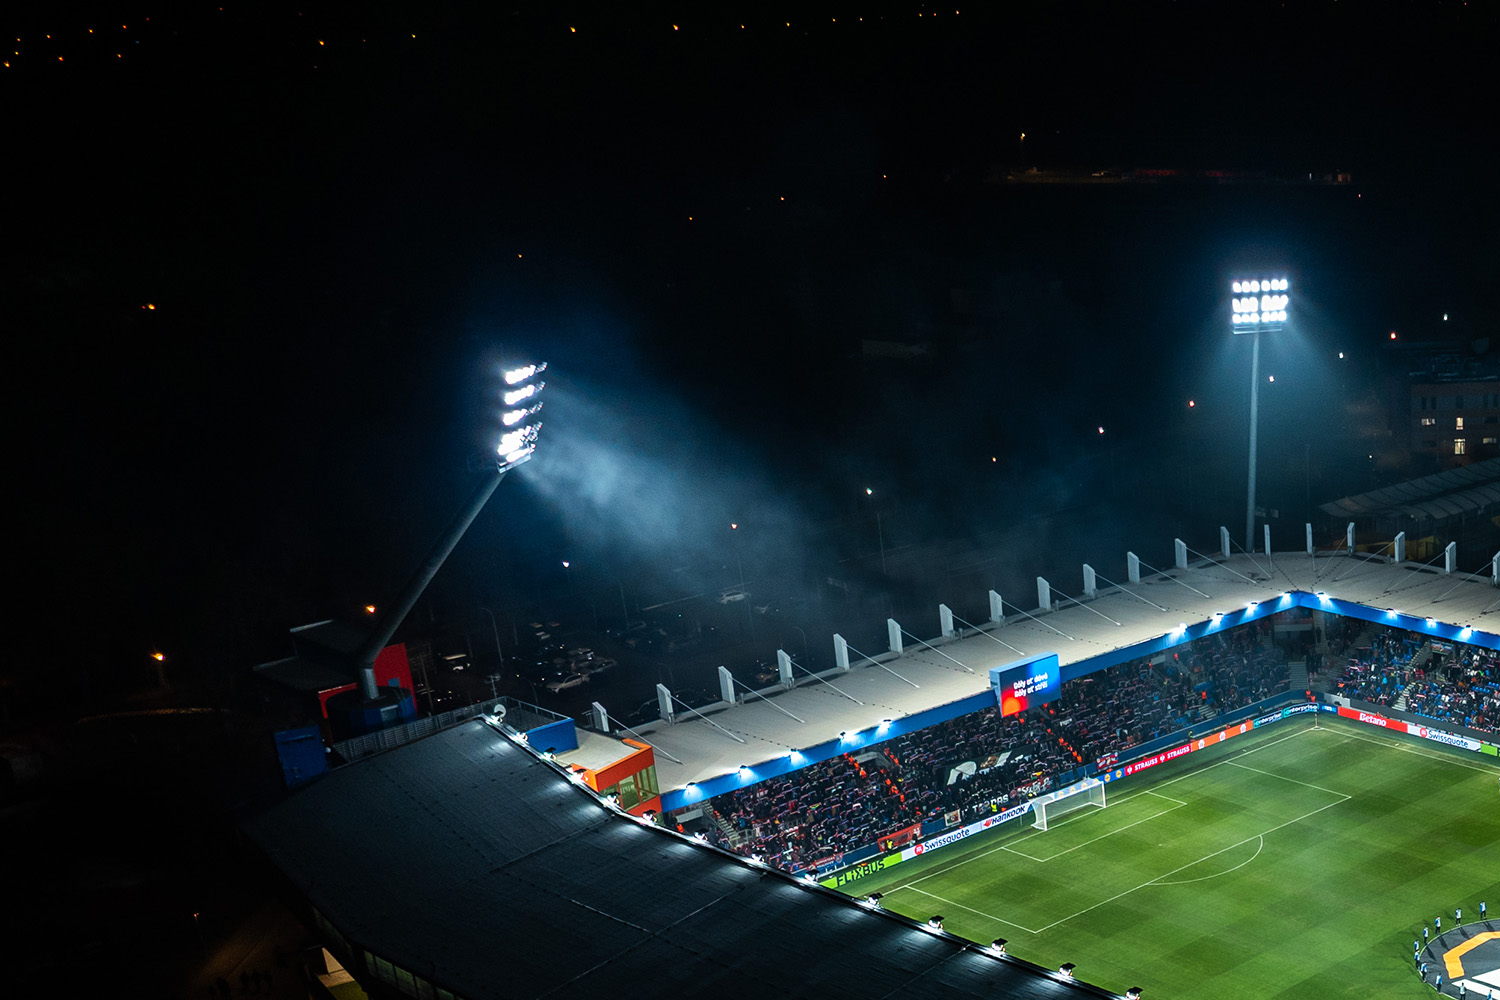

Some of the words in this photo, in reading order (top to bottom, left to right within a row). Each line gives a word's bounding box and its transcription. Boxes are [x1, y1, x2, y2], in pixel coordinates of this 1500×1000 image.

[1359, 712, 1387, 727] Betano
[1428, 730, 1469, 749] Swissquote
[1134, 757, 1158, 771] STRAUSS
[1167, 745, 1190, 759] STRAUSS
[924, 827, 970, 851] Swissquote
